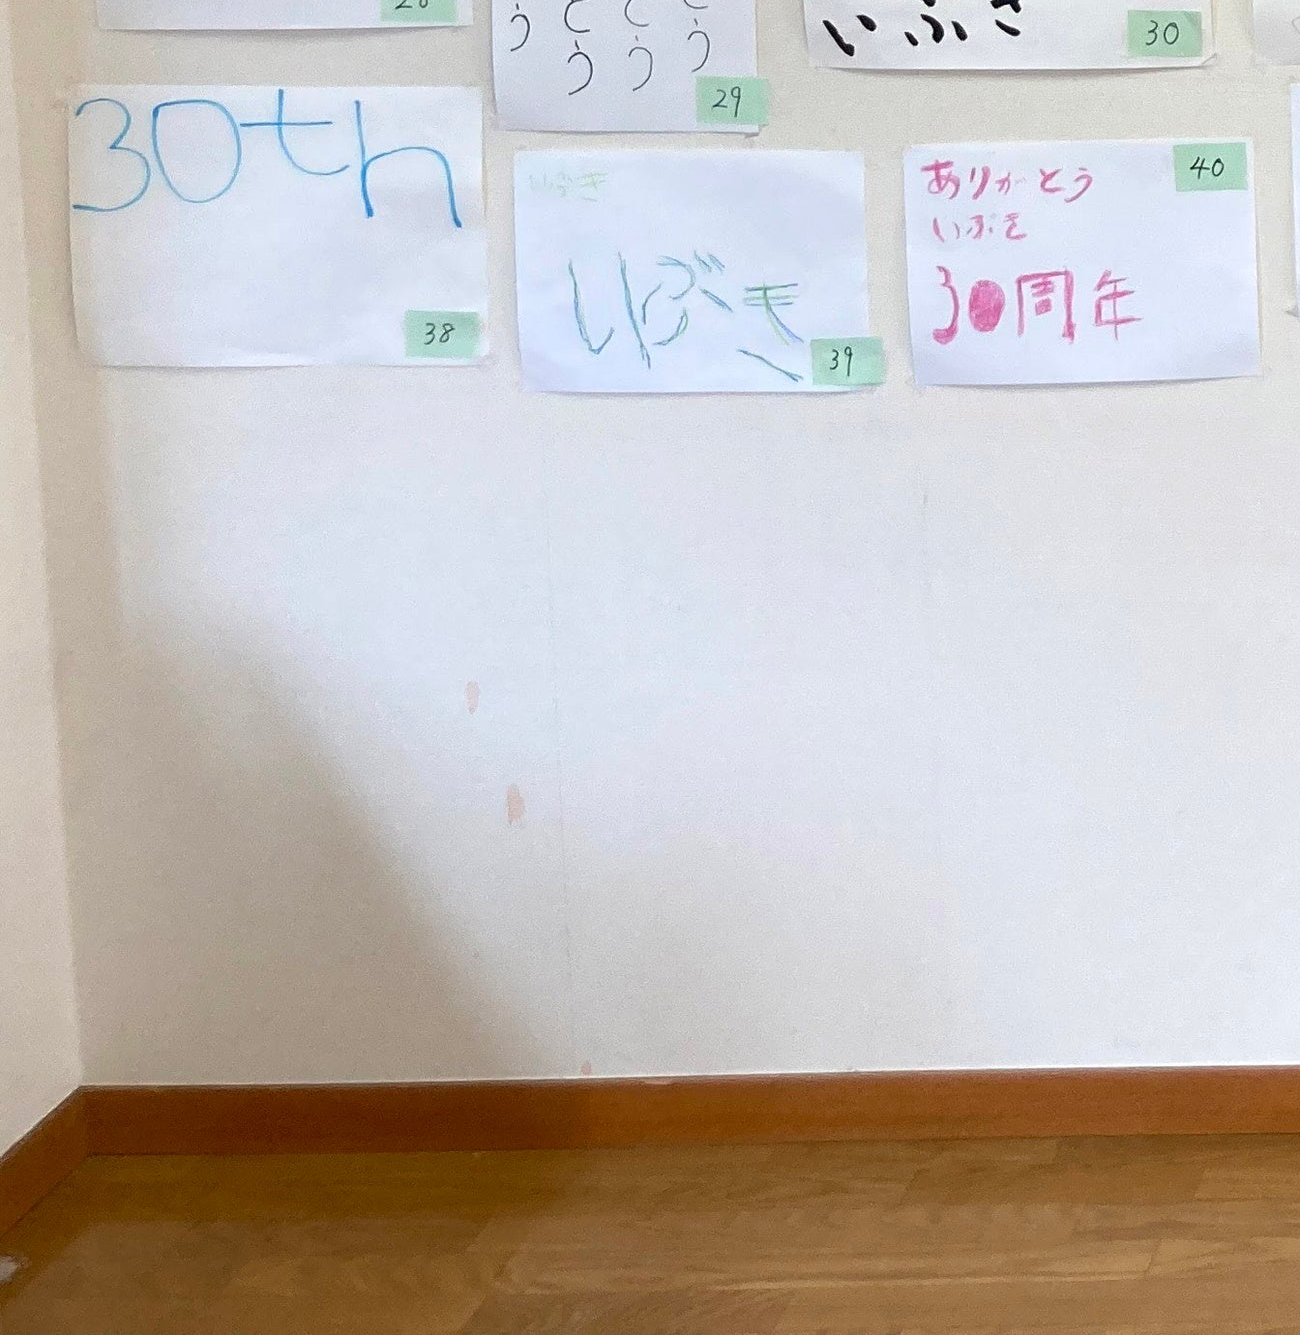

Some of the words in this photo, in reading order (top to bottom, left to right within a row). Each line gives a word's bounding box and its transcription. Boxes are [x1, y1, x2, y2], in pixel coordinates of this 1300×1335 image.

[1147, 20, 1182, 47] 30
[712, 86, 745, 112] 29
[72, 89, 463, 228] 30th
[1190, 156, 1225, 179] 40
[921, 160, 1093, 203] ありがとう
[568, 251, 803, 381] いぶき
[932, 265, 1142, 345] 30周年
[424, 323, 456, 346] 38
[830, 347, 853, 374] 39
